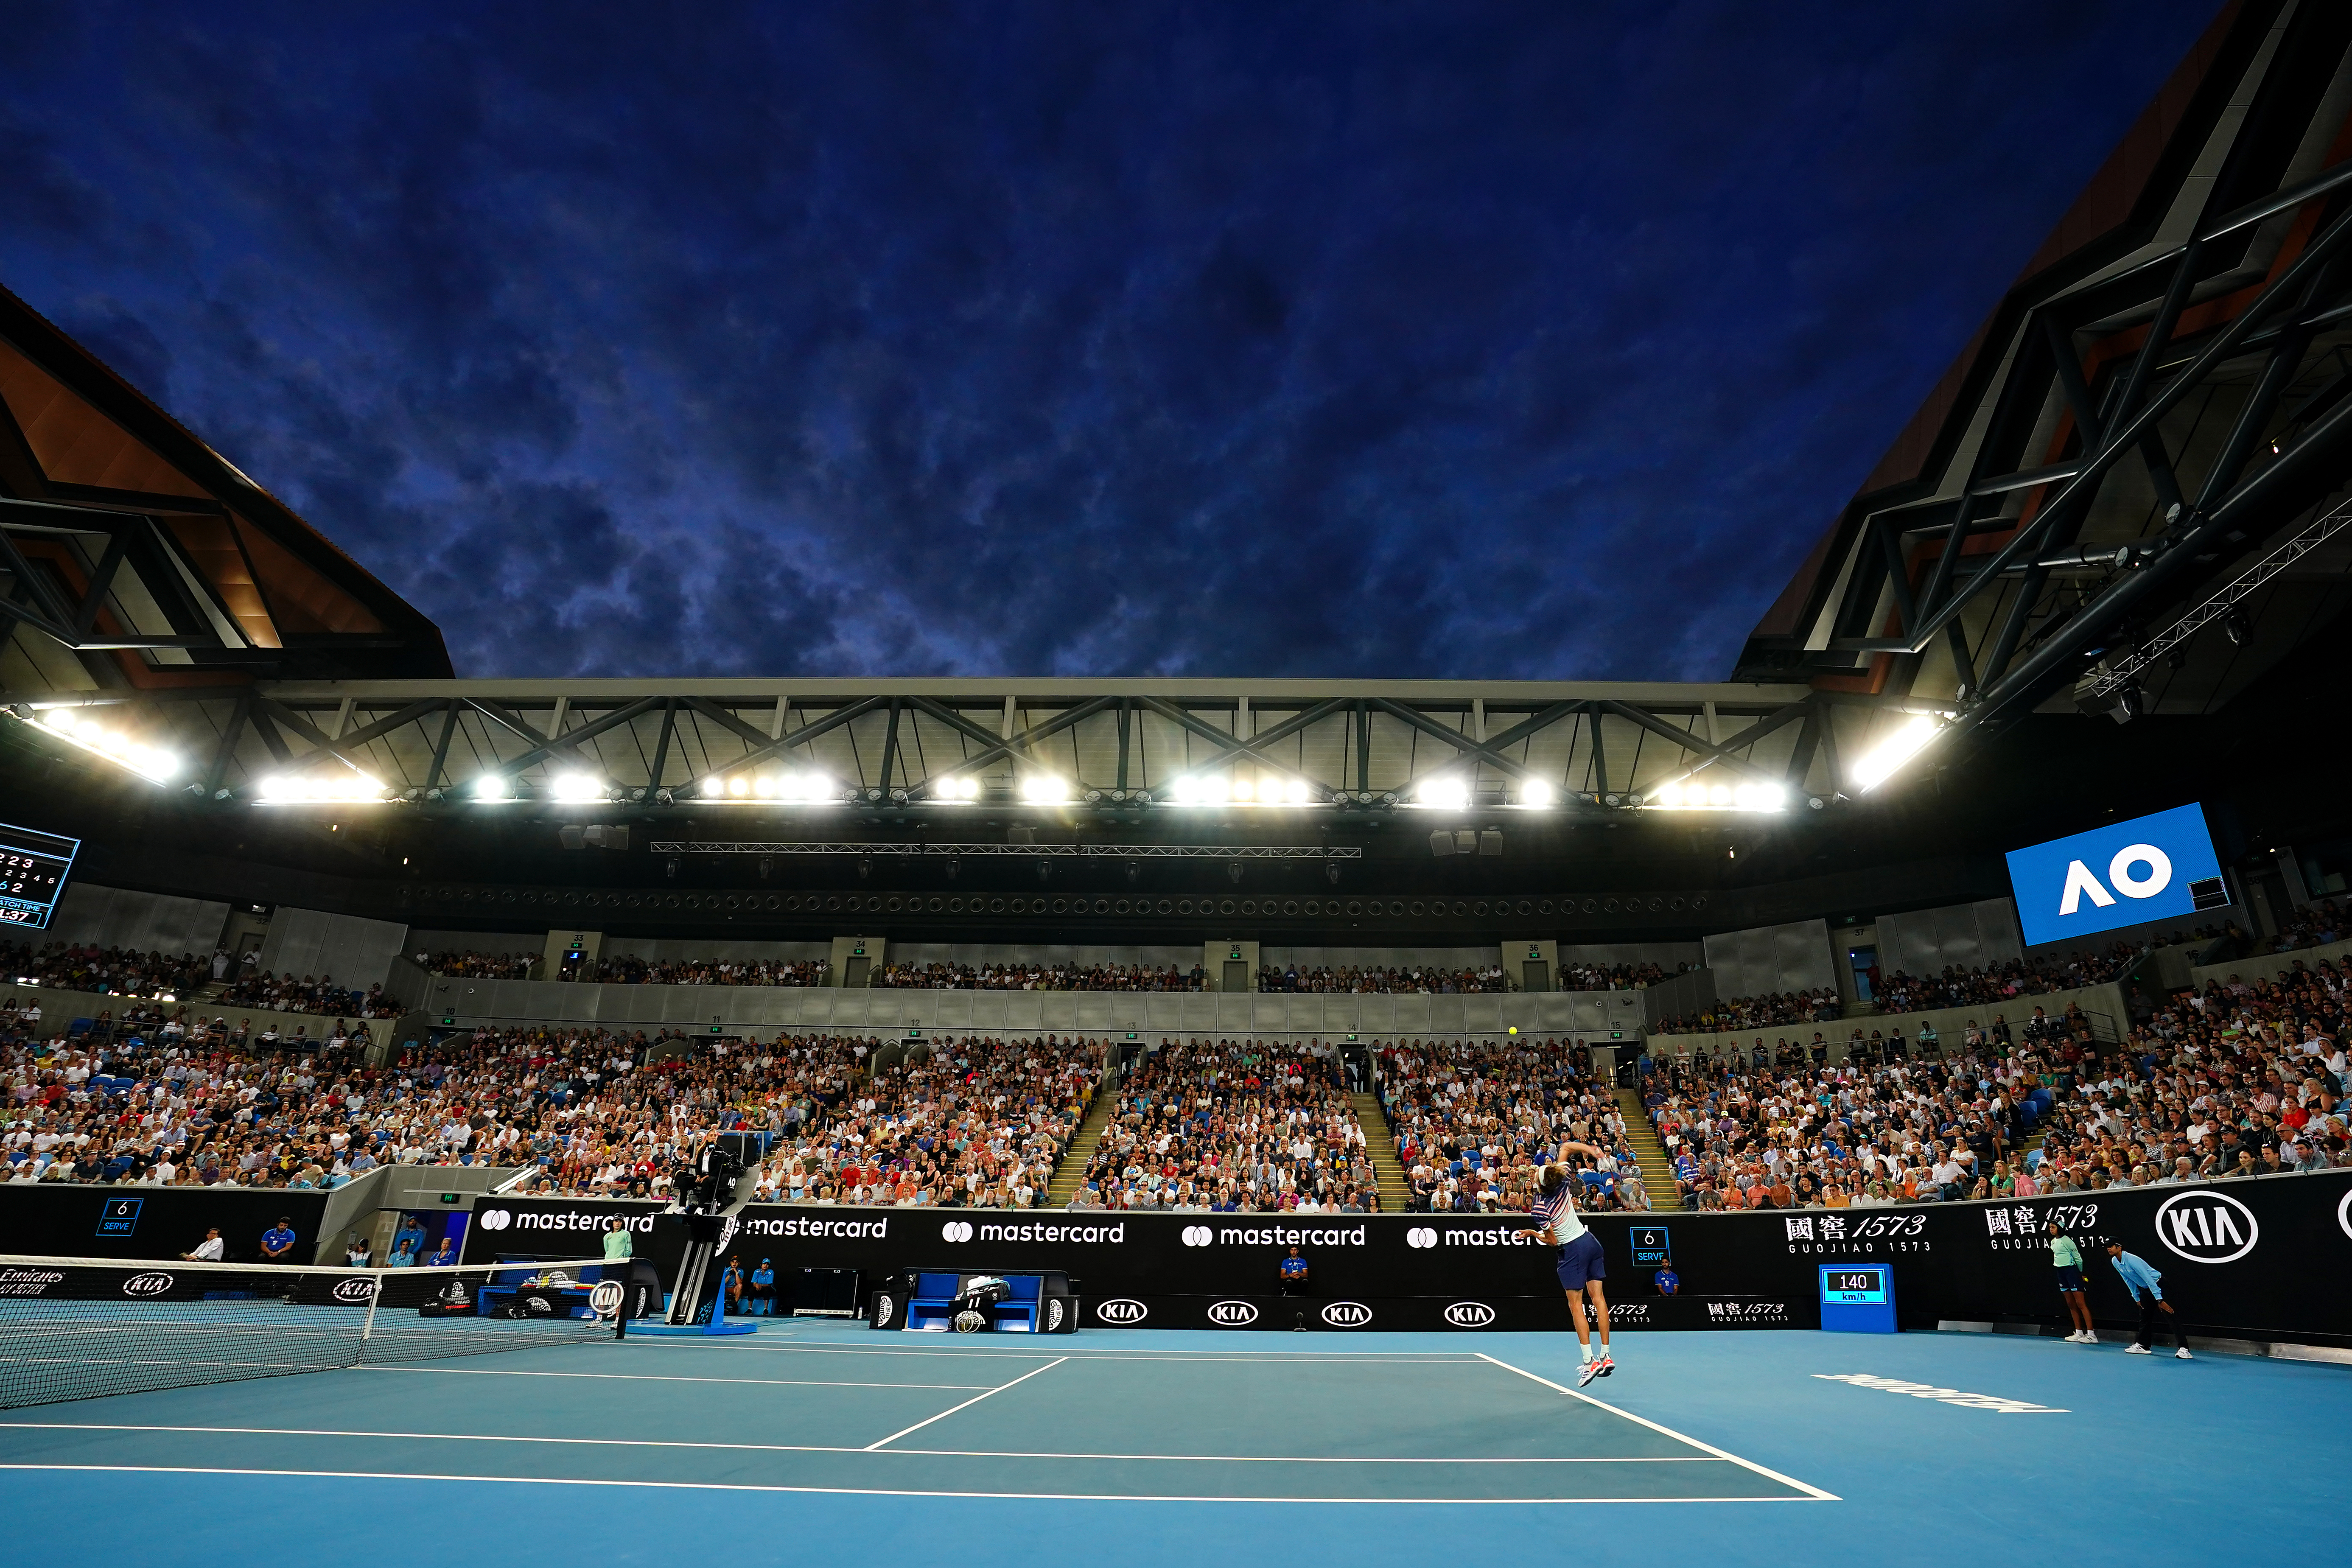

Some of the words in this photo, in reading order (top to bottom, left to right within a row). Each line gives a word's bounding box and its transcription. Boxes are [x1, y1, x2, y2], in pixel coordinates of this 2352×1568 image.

[2059, 844, 2172, 915] AO
[11, 883, 22, 893] 2
[118, 1202, 127, 1214] 6
[104, 1222, 130, 1230] SERVE
[747, 1217, 887, 1238] mastercard
[1852, 1215, 1926, 1237] 1573
[2168, 1207, 2243, 1246] KIA
[981, 1223, 1123, 1243] mastercard
[1221, 1225, 1365, 1246] mastercard
[1645, 1231, 1654, 1245] 6
[1789, 1243, 1873, 1253] GUOJIAO
[1889, 1242, 1930, 1252] 1573
[1991, 1238, 2050, 1249] GUOJIA
[2072, 1236, 2105, 1248] 573
[0, 1269, 65, 1282] Emirates
[1840, 1275, 1867, 1289] 140
[131, 1277, 165, 1291] KIA
[341, 1282, 373, 1295] KIA
[595, 1288, 617, 1305] KIA
[1842, 1292, 1866, 1301] km/h
[1106, 1305, 1138, 1318] KIA
[1217, 1307, 1249, 1320] KIA
[1330, 1308, 1364, 1321] KIA
[1453, 1308, 1487, 1321] KIA
[1744, 1303, 1784, 1314] 1573
